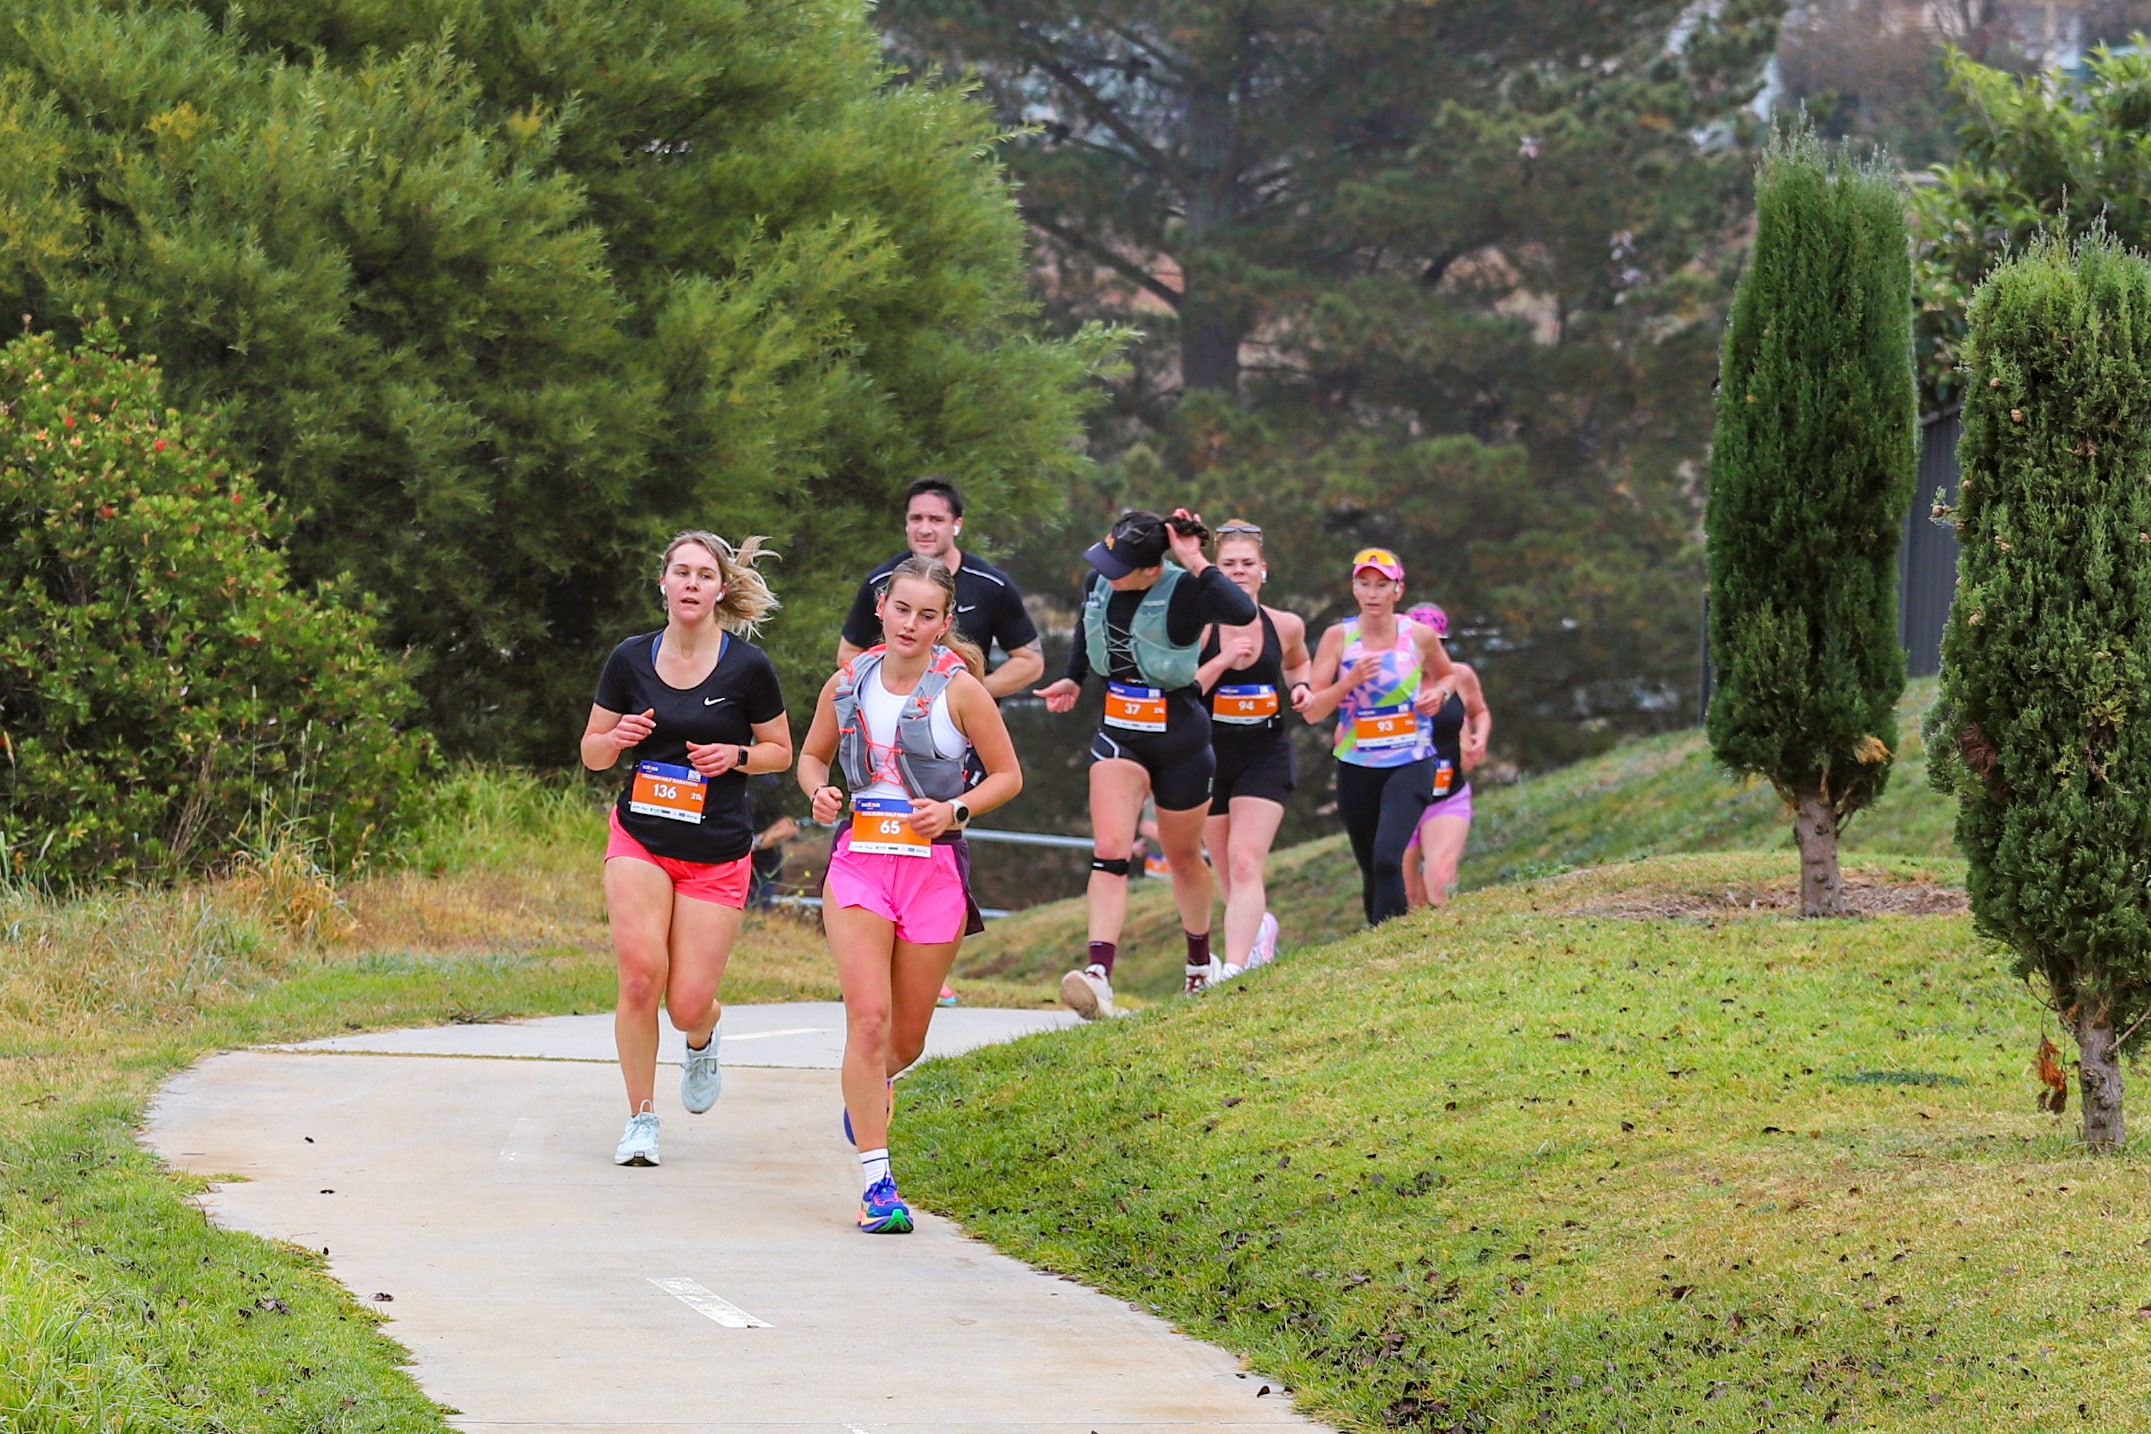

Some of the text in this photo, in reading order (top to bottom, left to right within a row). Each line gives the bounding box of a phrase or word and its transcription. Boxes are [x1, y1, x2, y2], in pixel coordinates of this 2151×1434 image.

[1124, 703, 1141, 715] 37
[1238, 700, 1255, 711] 94
[1377, 720, 1393, 732] 93
[653, 783, 677, 800] 136
[880, 820, 901, 835] 65
